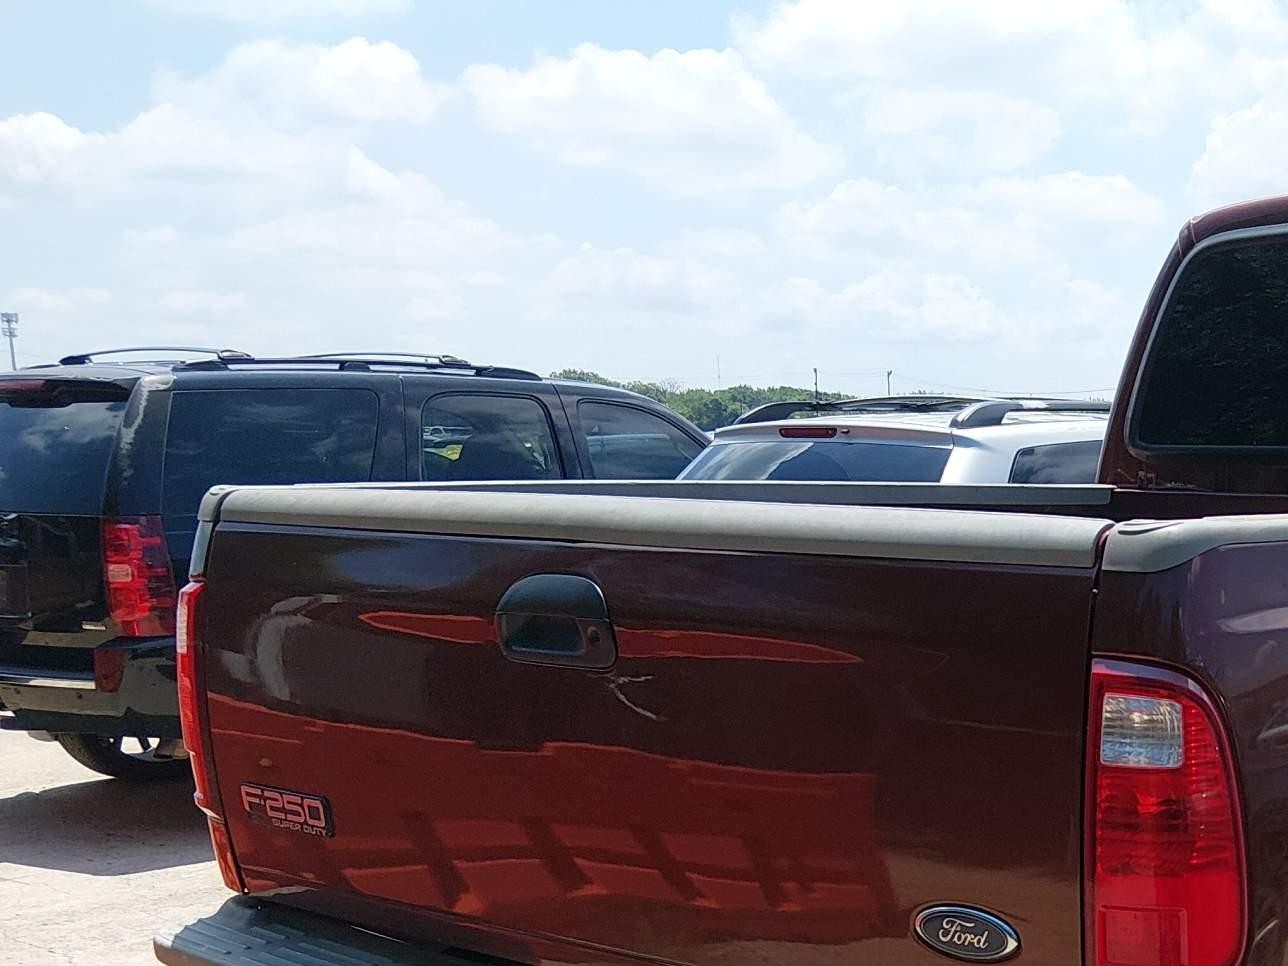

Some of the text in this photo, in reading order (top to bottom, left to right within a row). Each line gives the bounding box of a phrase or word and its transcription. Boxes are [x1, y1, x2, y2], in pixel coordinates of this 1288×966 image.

[272, 818, 327, 838] SUPER DUTY
[938, 917, 989, 949] Ford
